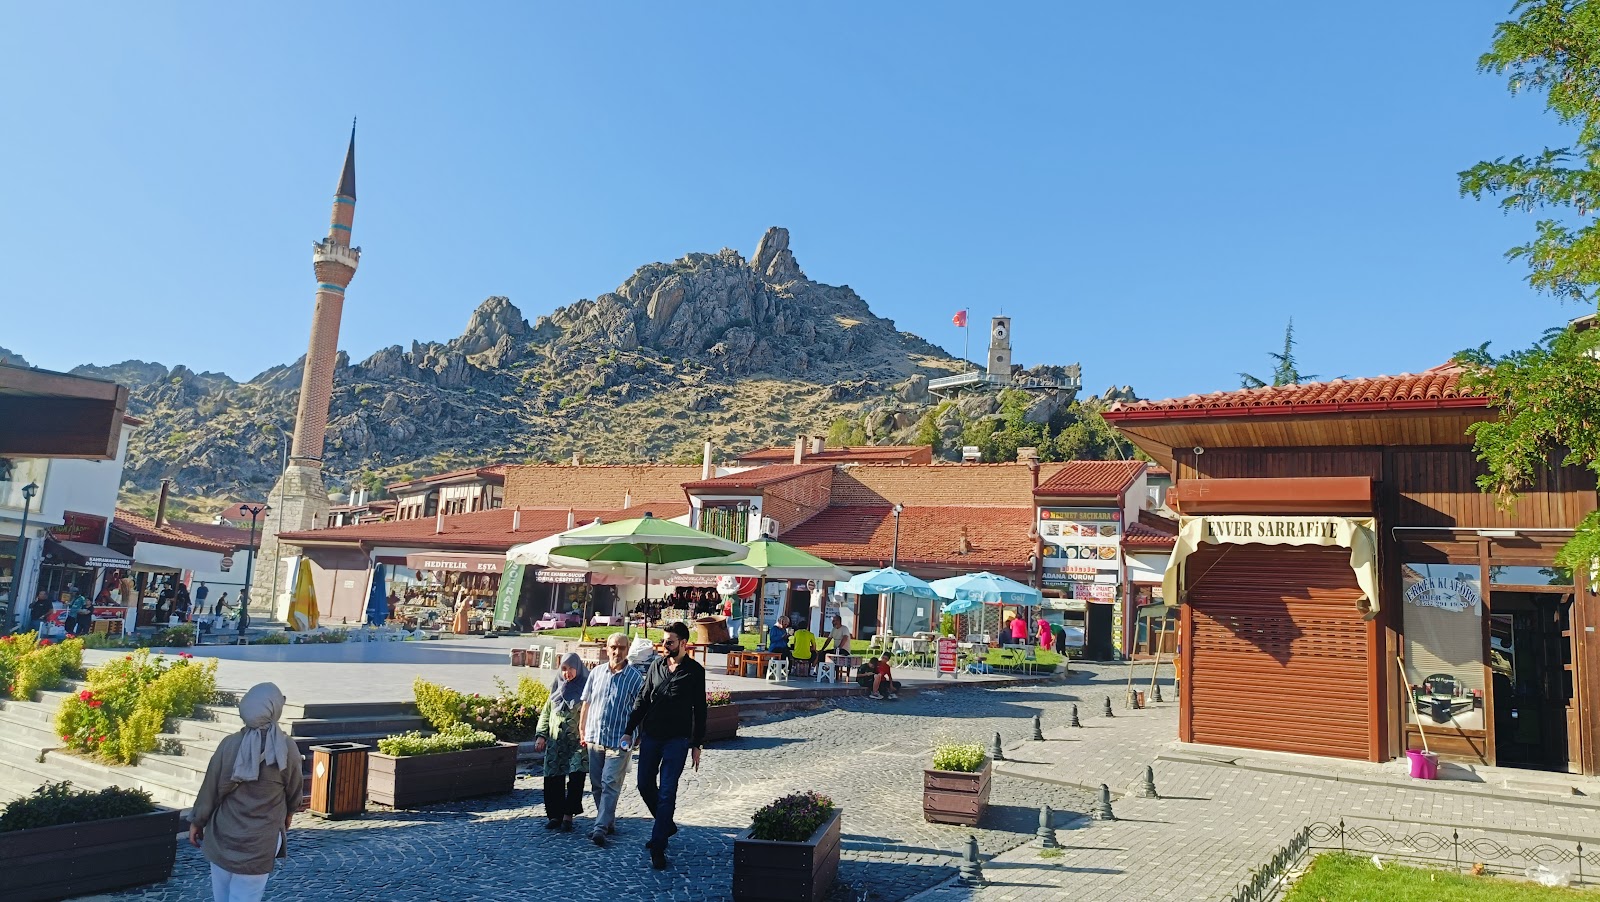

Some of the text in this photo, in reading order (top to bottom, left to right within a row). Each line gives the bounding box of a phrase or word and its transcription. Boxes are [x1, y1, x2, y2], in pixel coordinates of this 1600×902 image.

[1208, 521, 1338, 538] ENVER SARRAFiYE
[424, 560, 497, 571] HEDİYELİK EŞYA
[1405, 578, 1435, 603] ERKEK
